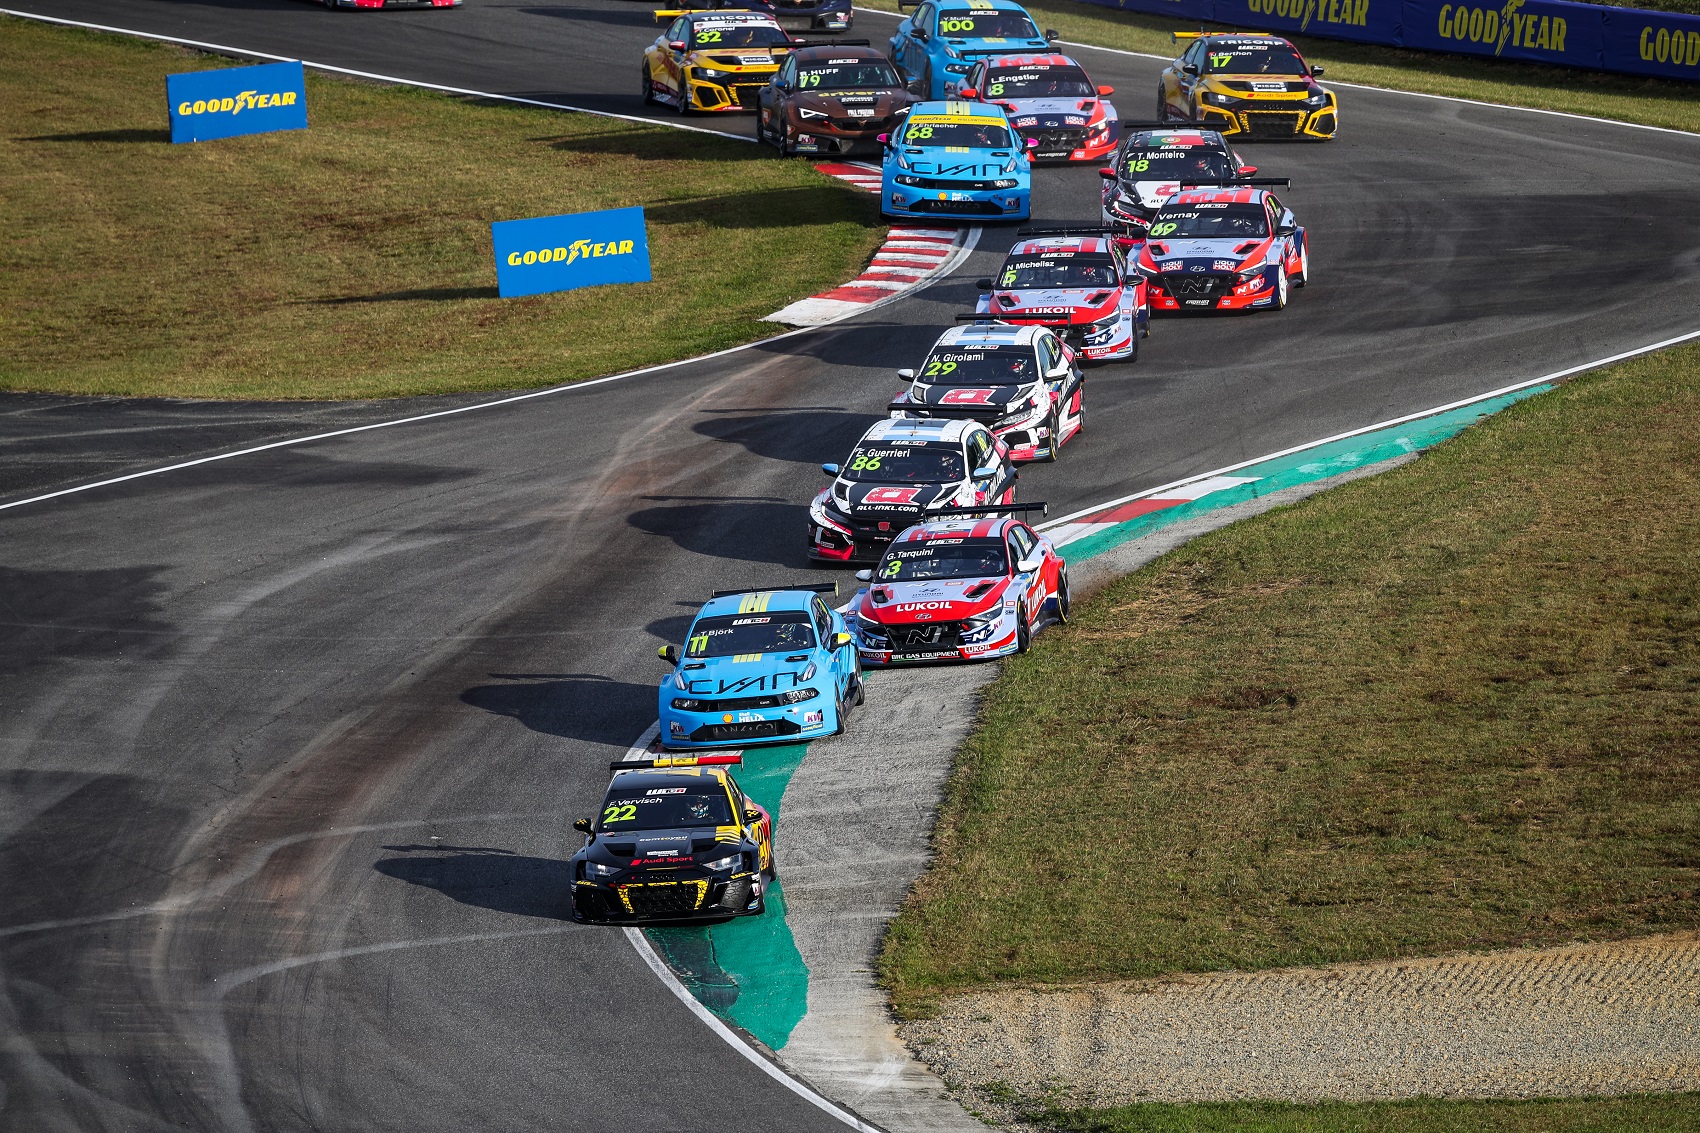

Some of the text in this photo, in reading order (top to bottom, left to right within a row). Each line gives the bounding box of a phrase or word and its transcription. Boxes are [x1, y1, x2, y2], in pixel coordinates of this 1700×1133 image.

[940, 20, 974, 32] 100
[1438, 4, 1567, 52] GOODYEAR
[697, 32, 722, 43] 32
[1210, 56, 1232, 67] 17
[799, 76, 820, 88] 19
[991, 84, 1004, 95] 8
[179, 91, 296, 115] GOODYEAR
[906, 127, 933, 139] 68
[1146, 151, 1185, 159] Monteiro
[1128, 160, 1149, 173] 18
[1158, 211, 1199, 220] Vernay
[1150, 223, 1177, 236] 69
[508, 240, 634, 266] GOODYEAR
[1016, 261, 1055, 269] Michelisz
[1003, 270, 1017, 284] 5
[1088, 347, 1111, 355] LUKOIL
[943, 353, 984, 362] Girolami
[925, 362, 957, 376] 29
[856, 448, 910, 458] E. Guerrieri
[851, 457, 881, 471] 86
[886, 549, 934, 561] G. Tarquini
[886, 560, 902, 576] 3
[896, 601, 952, 612] LUKOIL
[690, 635, 709, 653] 11
[964, 644, 991, 653] LUKOIL
[739, 712, 766, 723] HELIX
[807, 712, 821, 722] KW
[603, 805, 637, 823] 22
